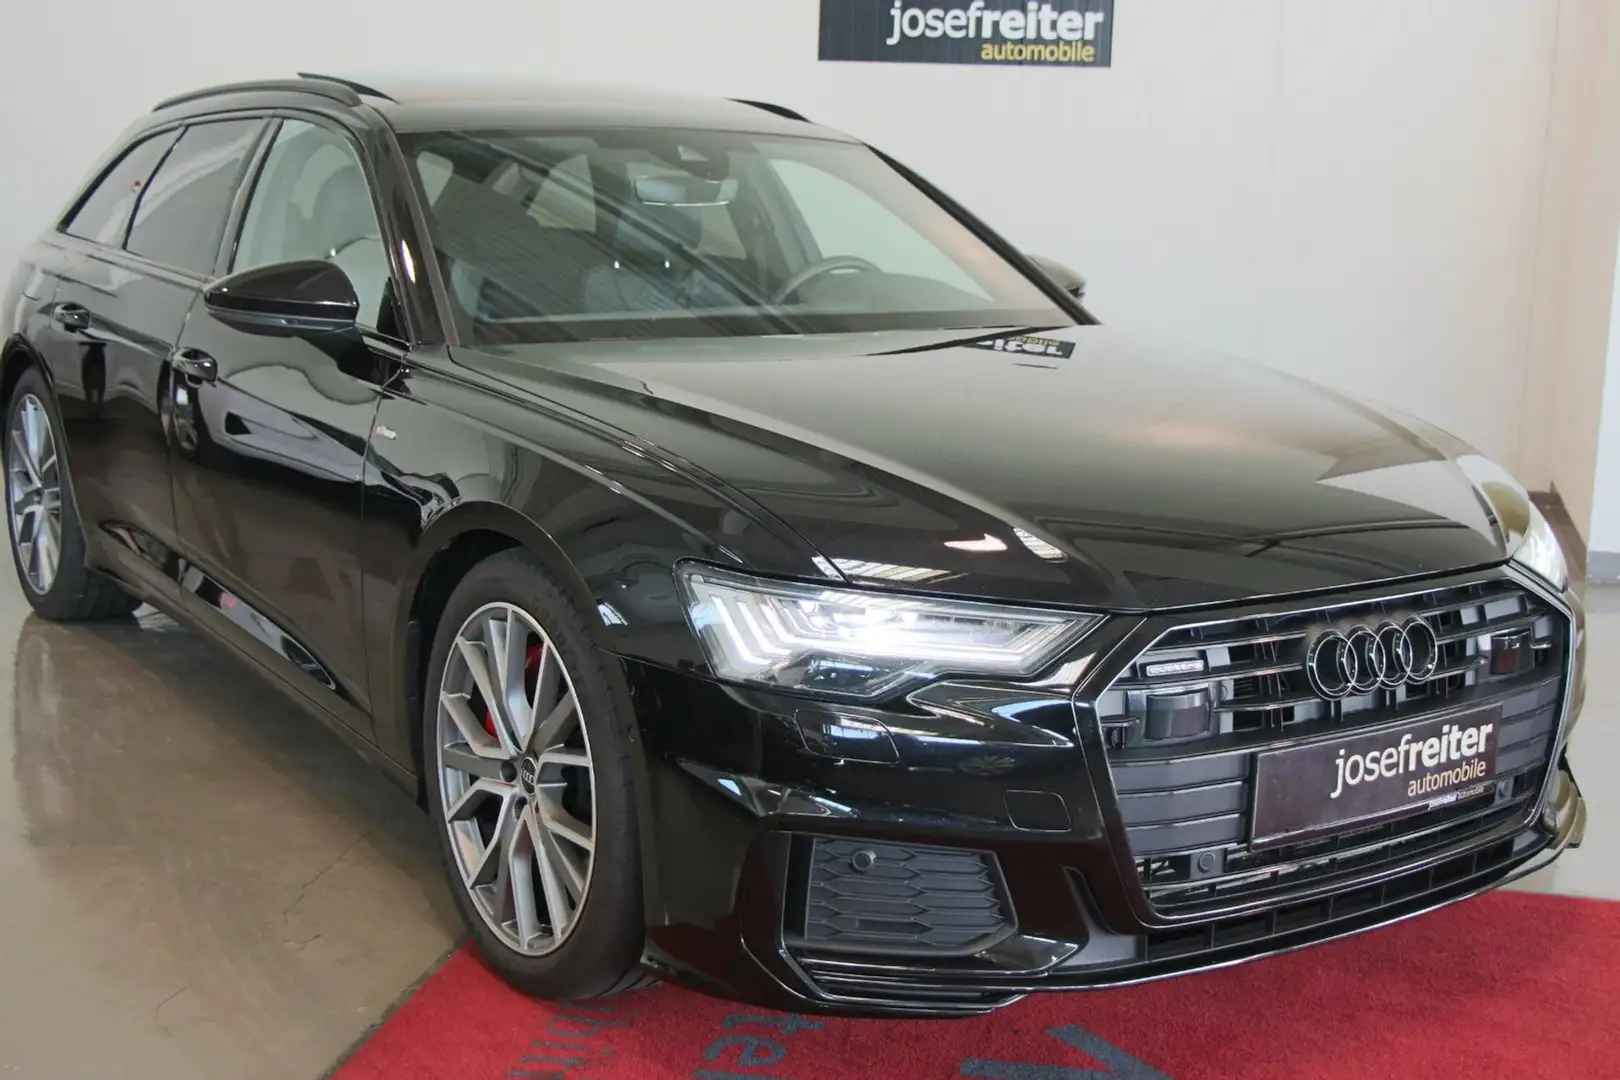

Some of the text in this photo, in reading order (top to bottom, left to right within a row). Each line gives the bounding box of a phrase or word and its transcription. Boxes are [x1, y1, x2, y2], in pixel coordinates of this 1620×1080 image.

[886, 0, 1104, 45] josefreiter
[981, 41, 1096, 62] automobile
[1330, 723, 1493, 799] josefreiter
[1407, 758, 1487, 797] automobile
